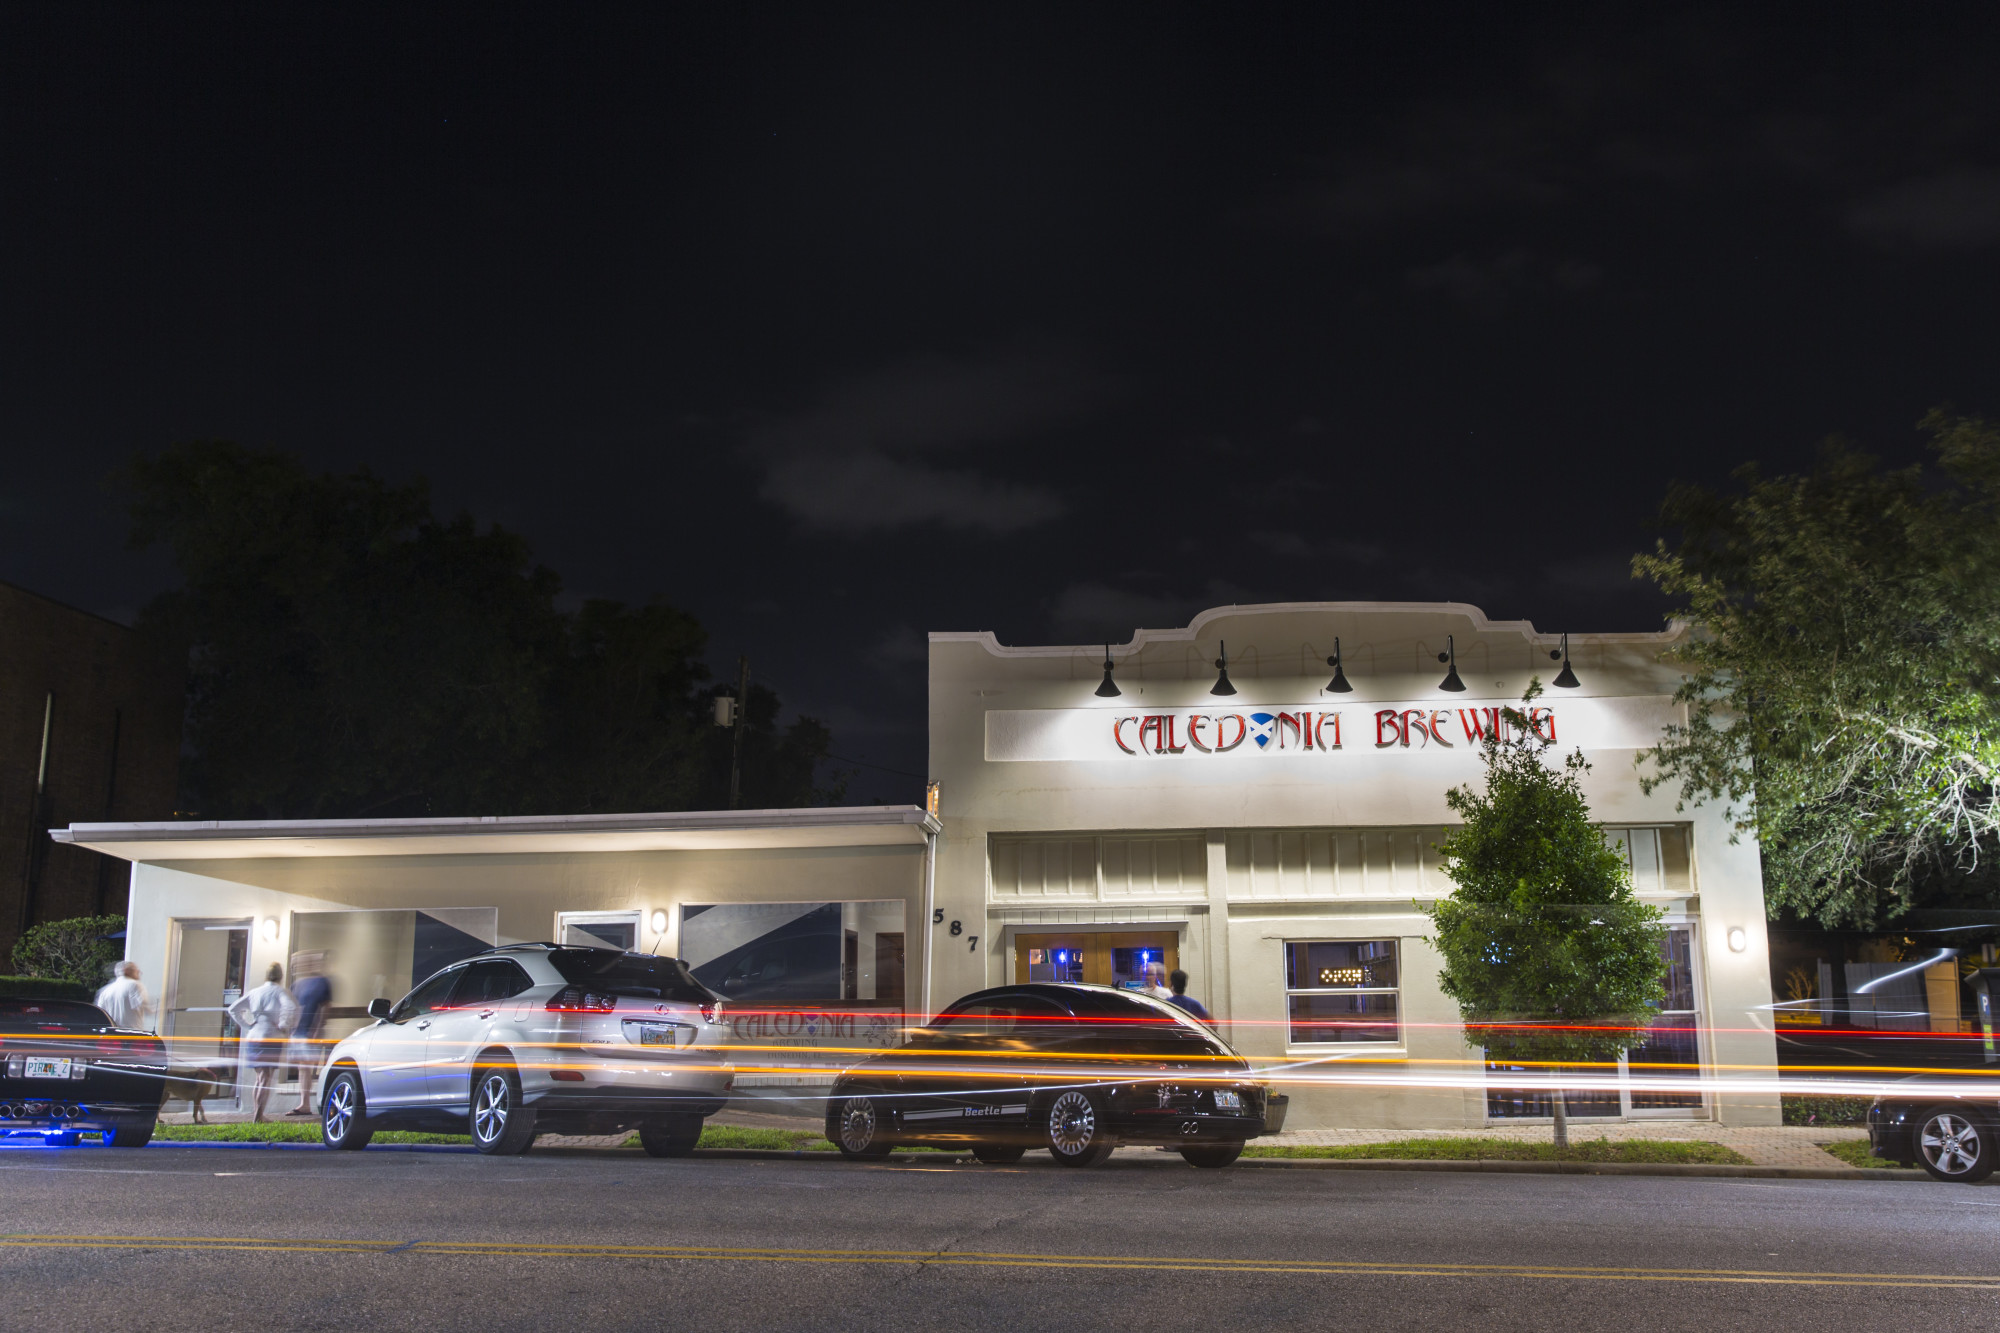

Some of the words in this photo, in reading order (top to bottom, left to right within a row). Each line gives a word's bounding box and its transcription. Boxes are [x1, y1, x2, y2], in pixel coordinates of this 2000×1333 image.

[1113, 711, 1343, 755] CALEDONIA
[1374, 706, 1558, 749] BREWING
[964, 1105, 1000, 1117] Beetle
